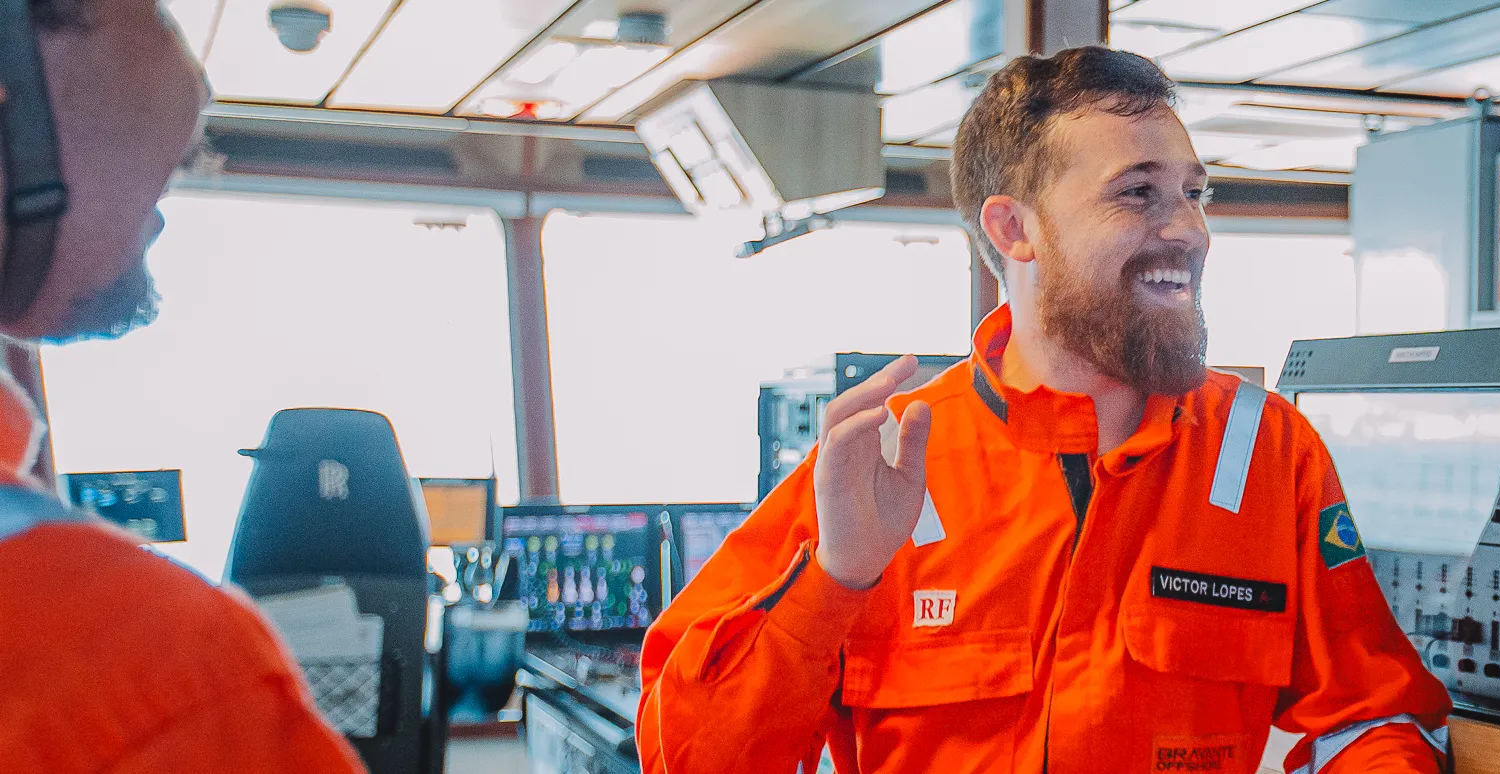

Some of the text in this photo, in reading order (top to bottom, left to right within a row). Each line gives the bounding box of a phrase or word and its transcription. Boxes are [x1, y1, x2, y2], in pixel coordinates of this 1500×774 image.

[1160, 574, 1208, 596] VICTOR
[1212, 582, 1253, 602] LOPES
[919, 598, 952, 620] RF
